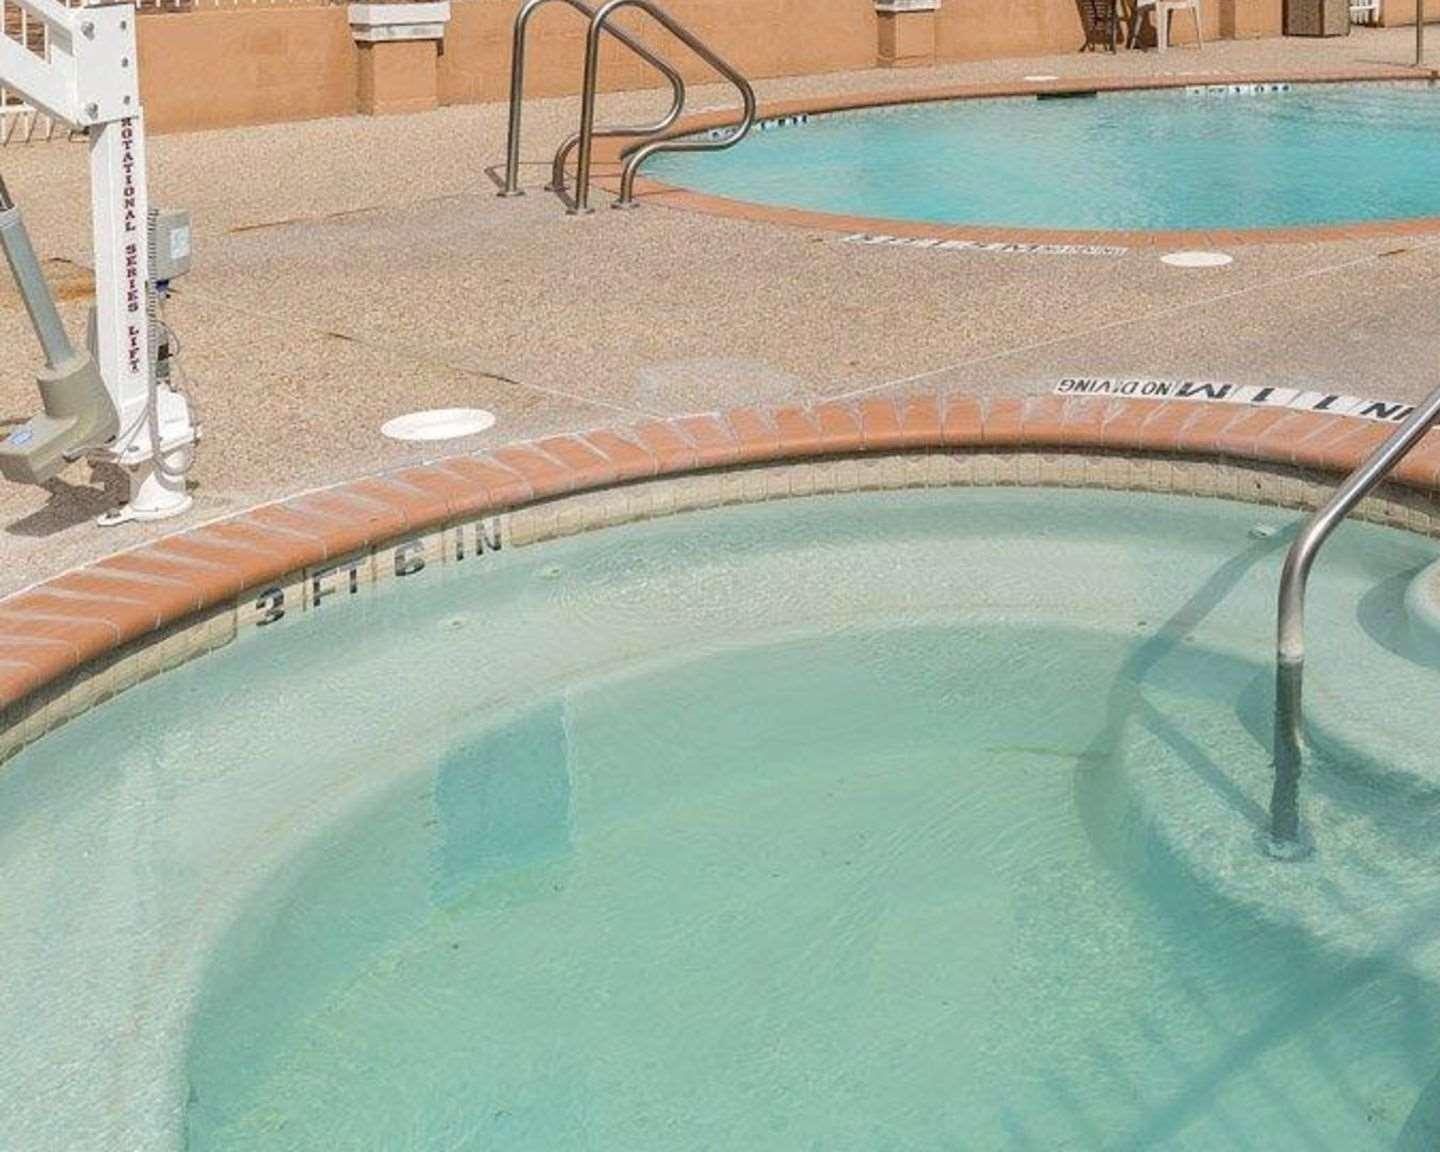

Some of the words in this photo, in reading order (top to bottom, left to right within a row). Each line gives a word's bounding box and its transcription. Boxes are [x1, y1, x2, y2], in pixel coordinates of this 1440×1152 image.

[126, 244, 139, 312] SERIES
[128, 326, 140, 372] LIFT
[1141, 382, 1172, 396] NO
[256, 587, 285, 627] 3
[313, 560, 365, 607] FT
[395, 540, 425, 577] 6
[456, 517, 502, 562] IN
